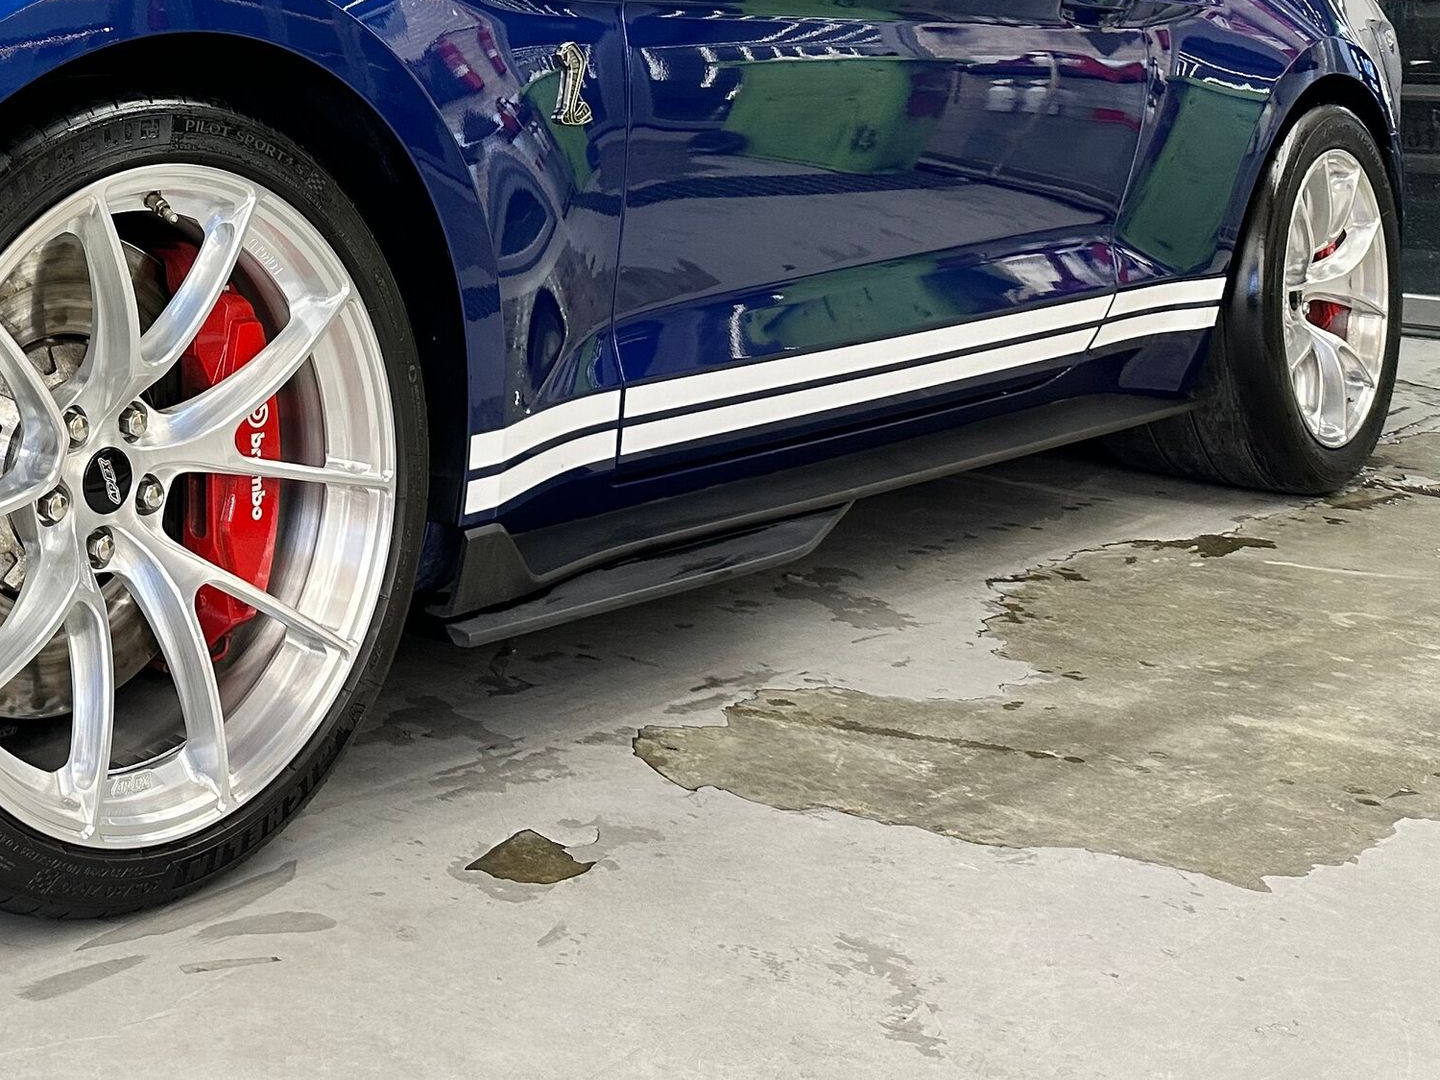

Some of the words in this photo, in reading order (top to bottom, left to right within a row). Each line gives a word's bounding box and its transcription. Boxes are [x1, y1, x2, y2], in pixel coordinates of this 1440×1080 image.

[185, 119, 231, 137] PILOT
[236, 130, 287, 161] SPORT
[98, 457, 122, 505] APEX
[250, 431, 266, 520] brmbo
